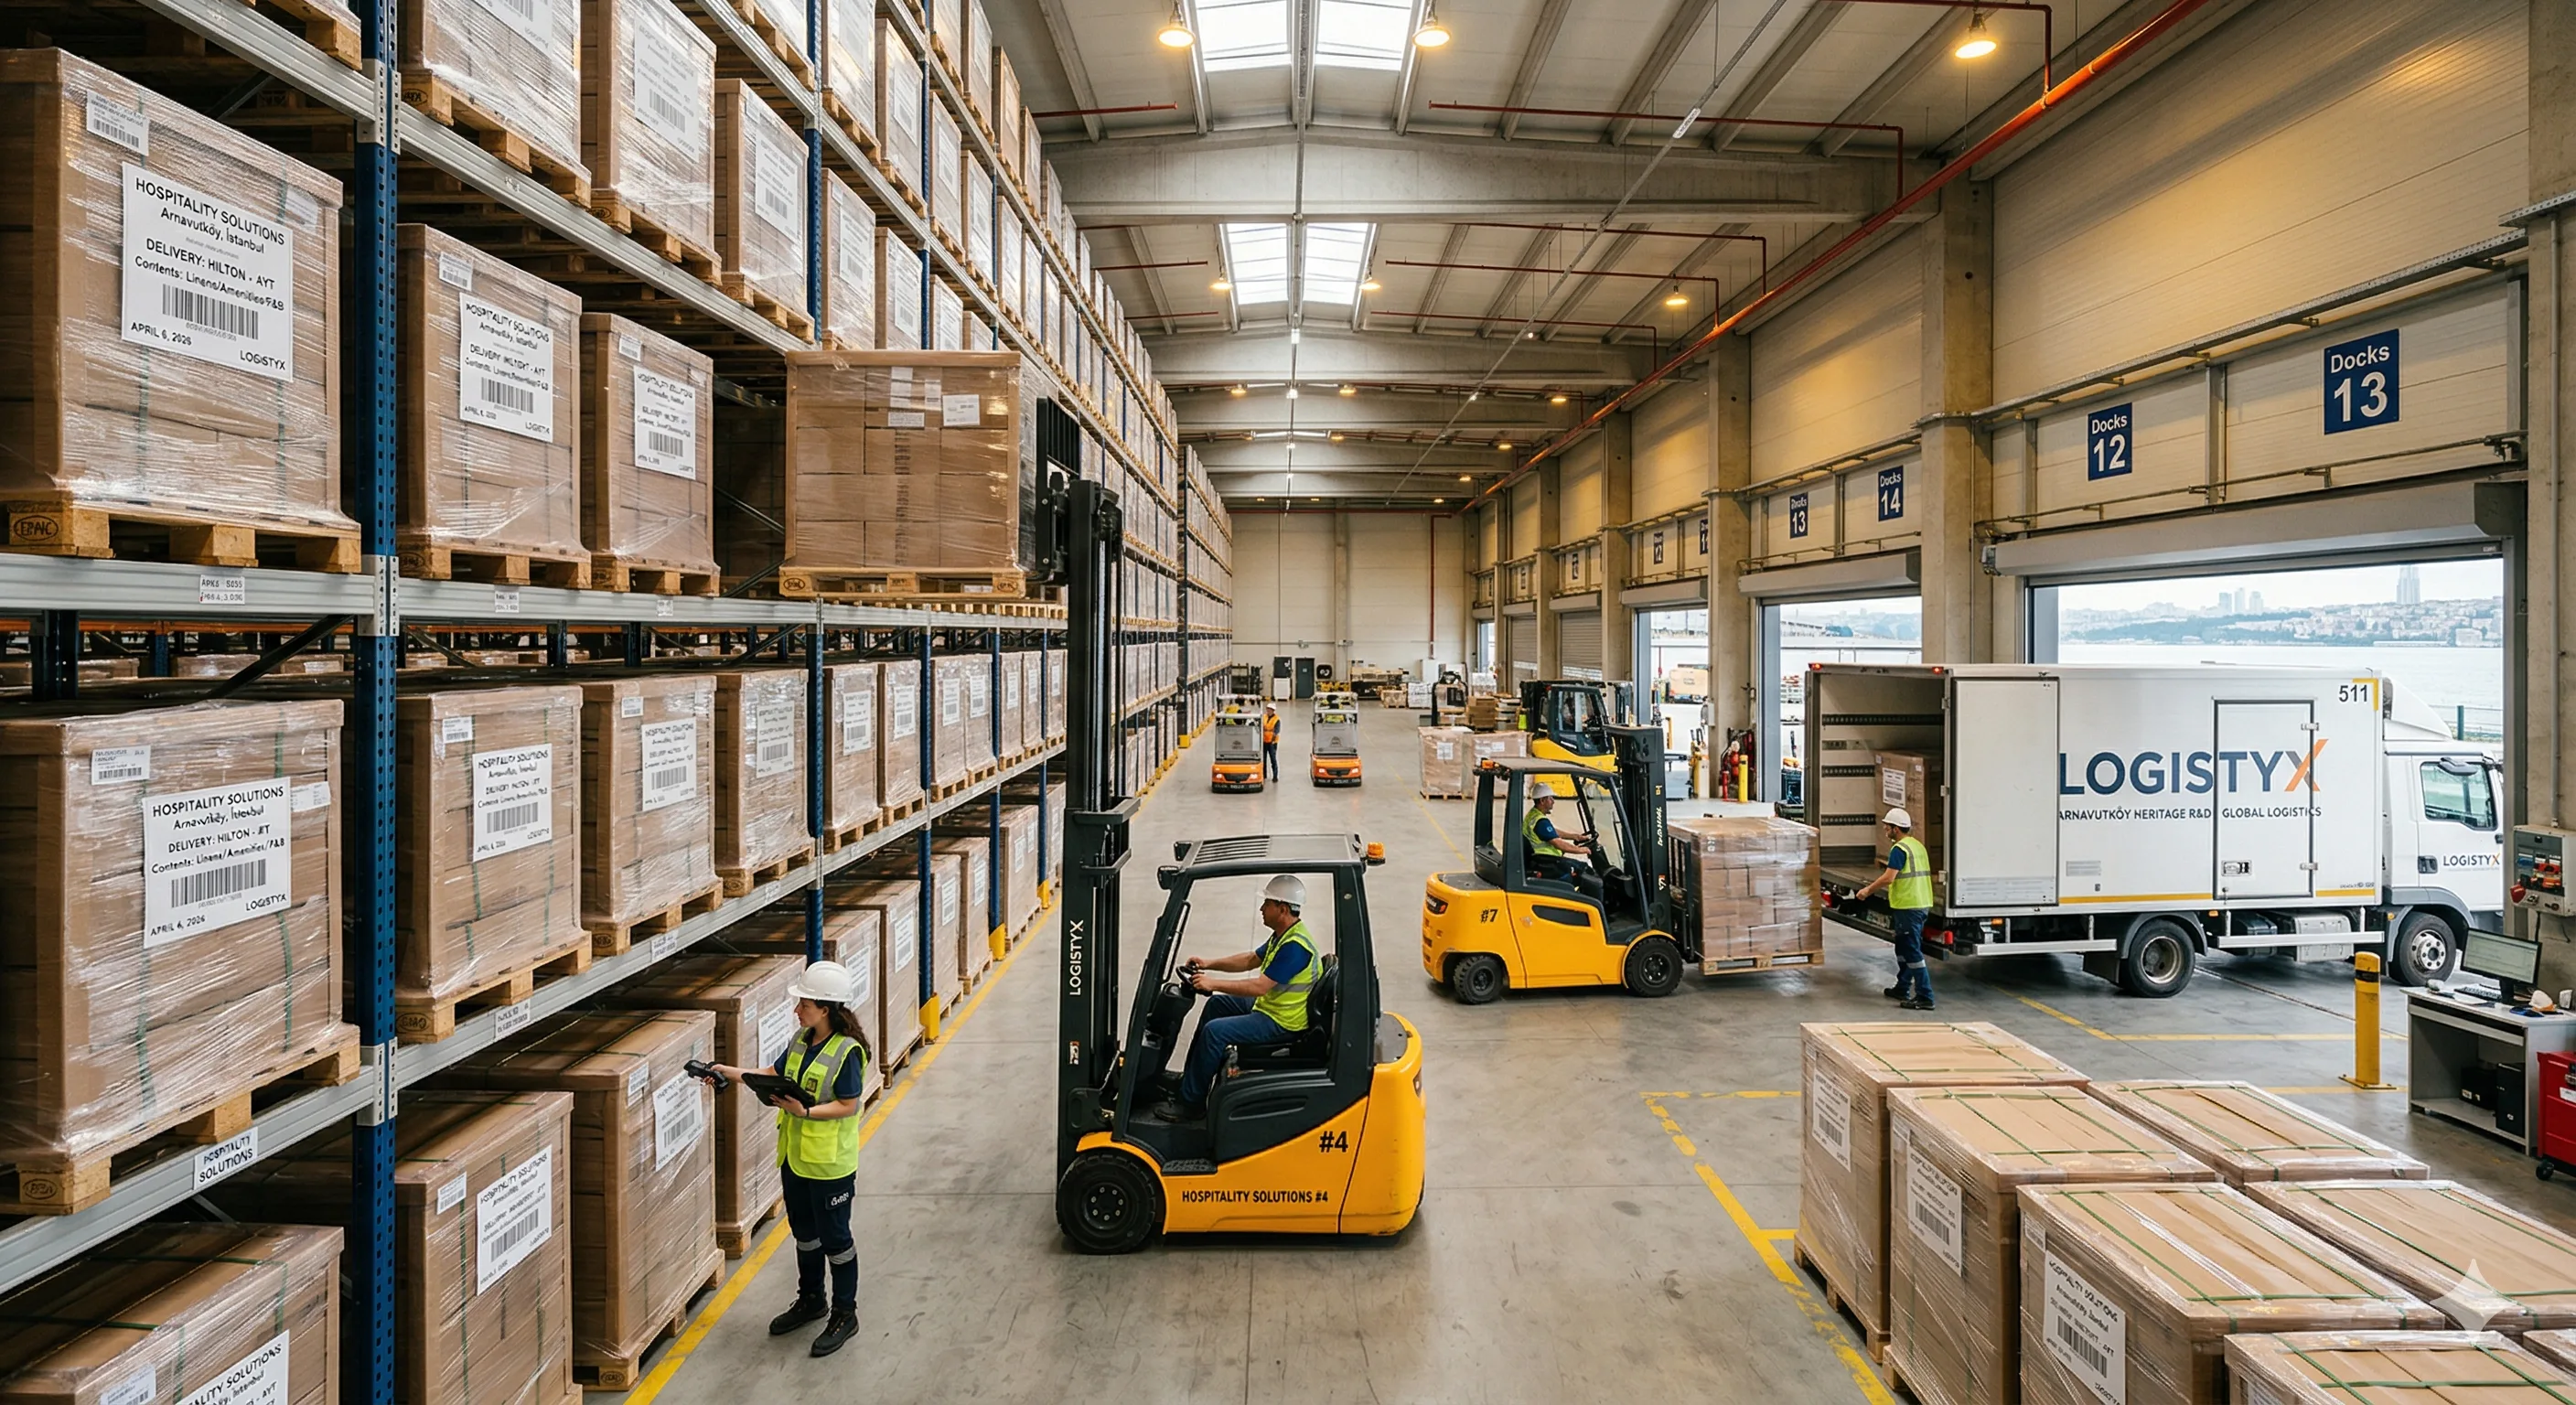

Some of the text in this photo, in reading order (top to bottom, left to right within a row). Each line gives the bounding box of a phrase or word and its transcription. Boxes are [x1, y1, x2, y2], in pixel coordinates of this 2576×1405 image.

[135, 177, 284, 245] HOSPITALITY SOLUTIONS
[147, 238, 205, 267] DELIVERY:
[209, 258, 246, 281] HILTON
[256, 274, 275, 290] AYT
[131, 322, 159, 338] APRIL
[240, 349, 285, 370] LOGISTYX
[2331, 344, 2390, 373] Docks
[2334, 371, 2388, 422] 13
[2092, 413, 2128, 434] Docks
[2093, 434, 2126, 472] 12
[1880, 472, 1902, 488] Docks
[1881, 488, 1901, 515] 14
[1792, 510, 1806, 534] 13
[2338, 684, 2367, 702] 511
[2059, 739, 2328, 795] LOGISTYX
[153, 786, 284, 818] HOSPITALITY SOLUTIONS
[2134, 809, 2185, 820] HERITAGE
[2189, 808, 2211, 819] R&D
[2222, 808, 2265, 818] GLOBAL
[2267, 806, 2322, 818] LOGISTICS
[168, 835, 216, 853] DELIVERY:
[218, 828, 250, 845] HILTON
[2443, 853, 2500, 867] LOGISTYX
[1480, 908, 1498, 923] #7
[150, 923, 174, 937] APRIL
[1069, 919, 1084, 995] LOGISTYX
[1319, 1131, 1348, 1153] #4
[199, 1148, 253, 1183] SOLUTIONS
[1182, 1190, 1328, 1203] HOSPITALITY SOLUTIONS #4
[227, 1343, 282, 1389] SOLUTIONS
